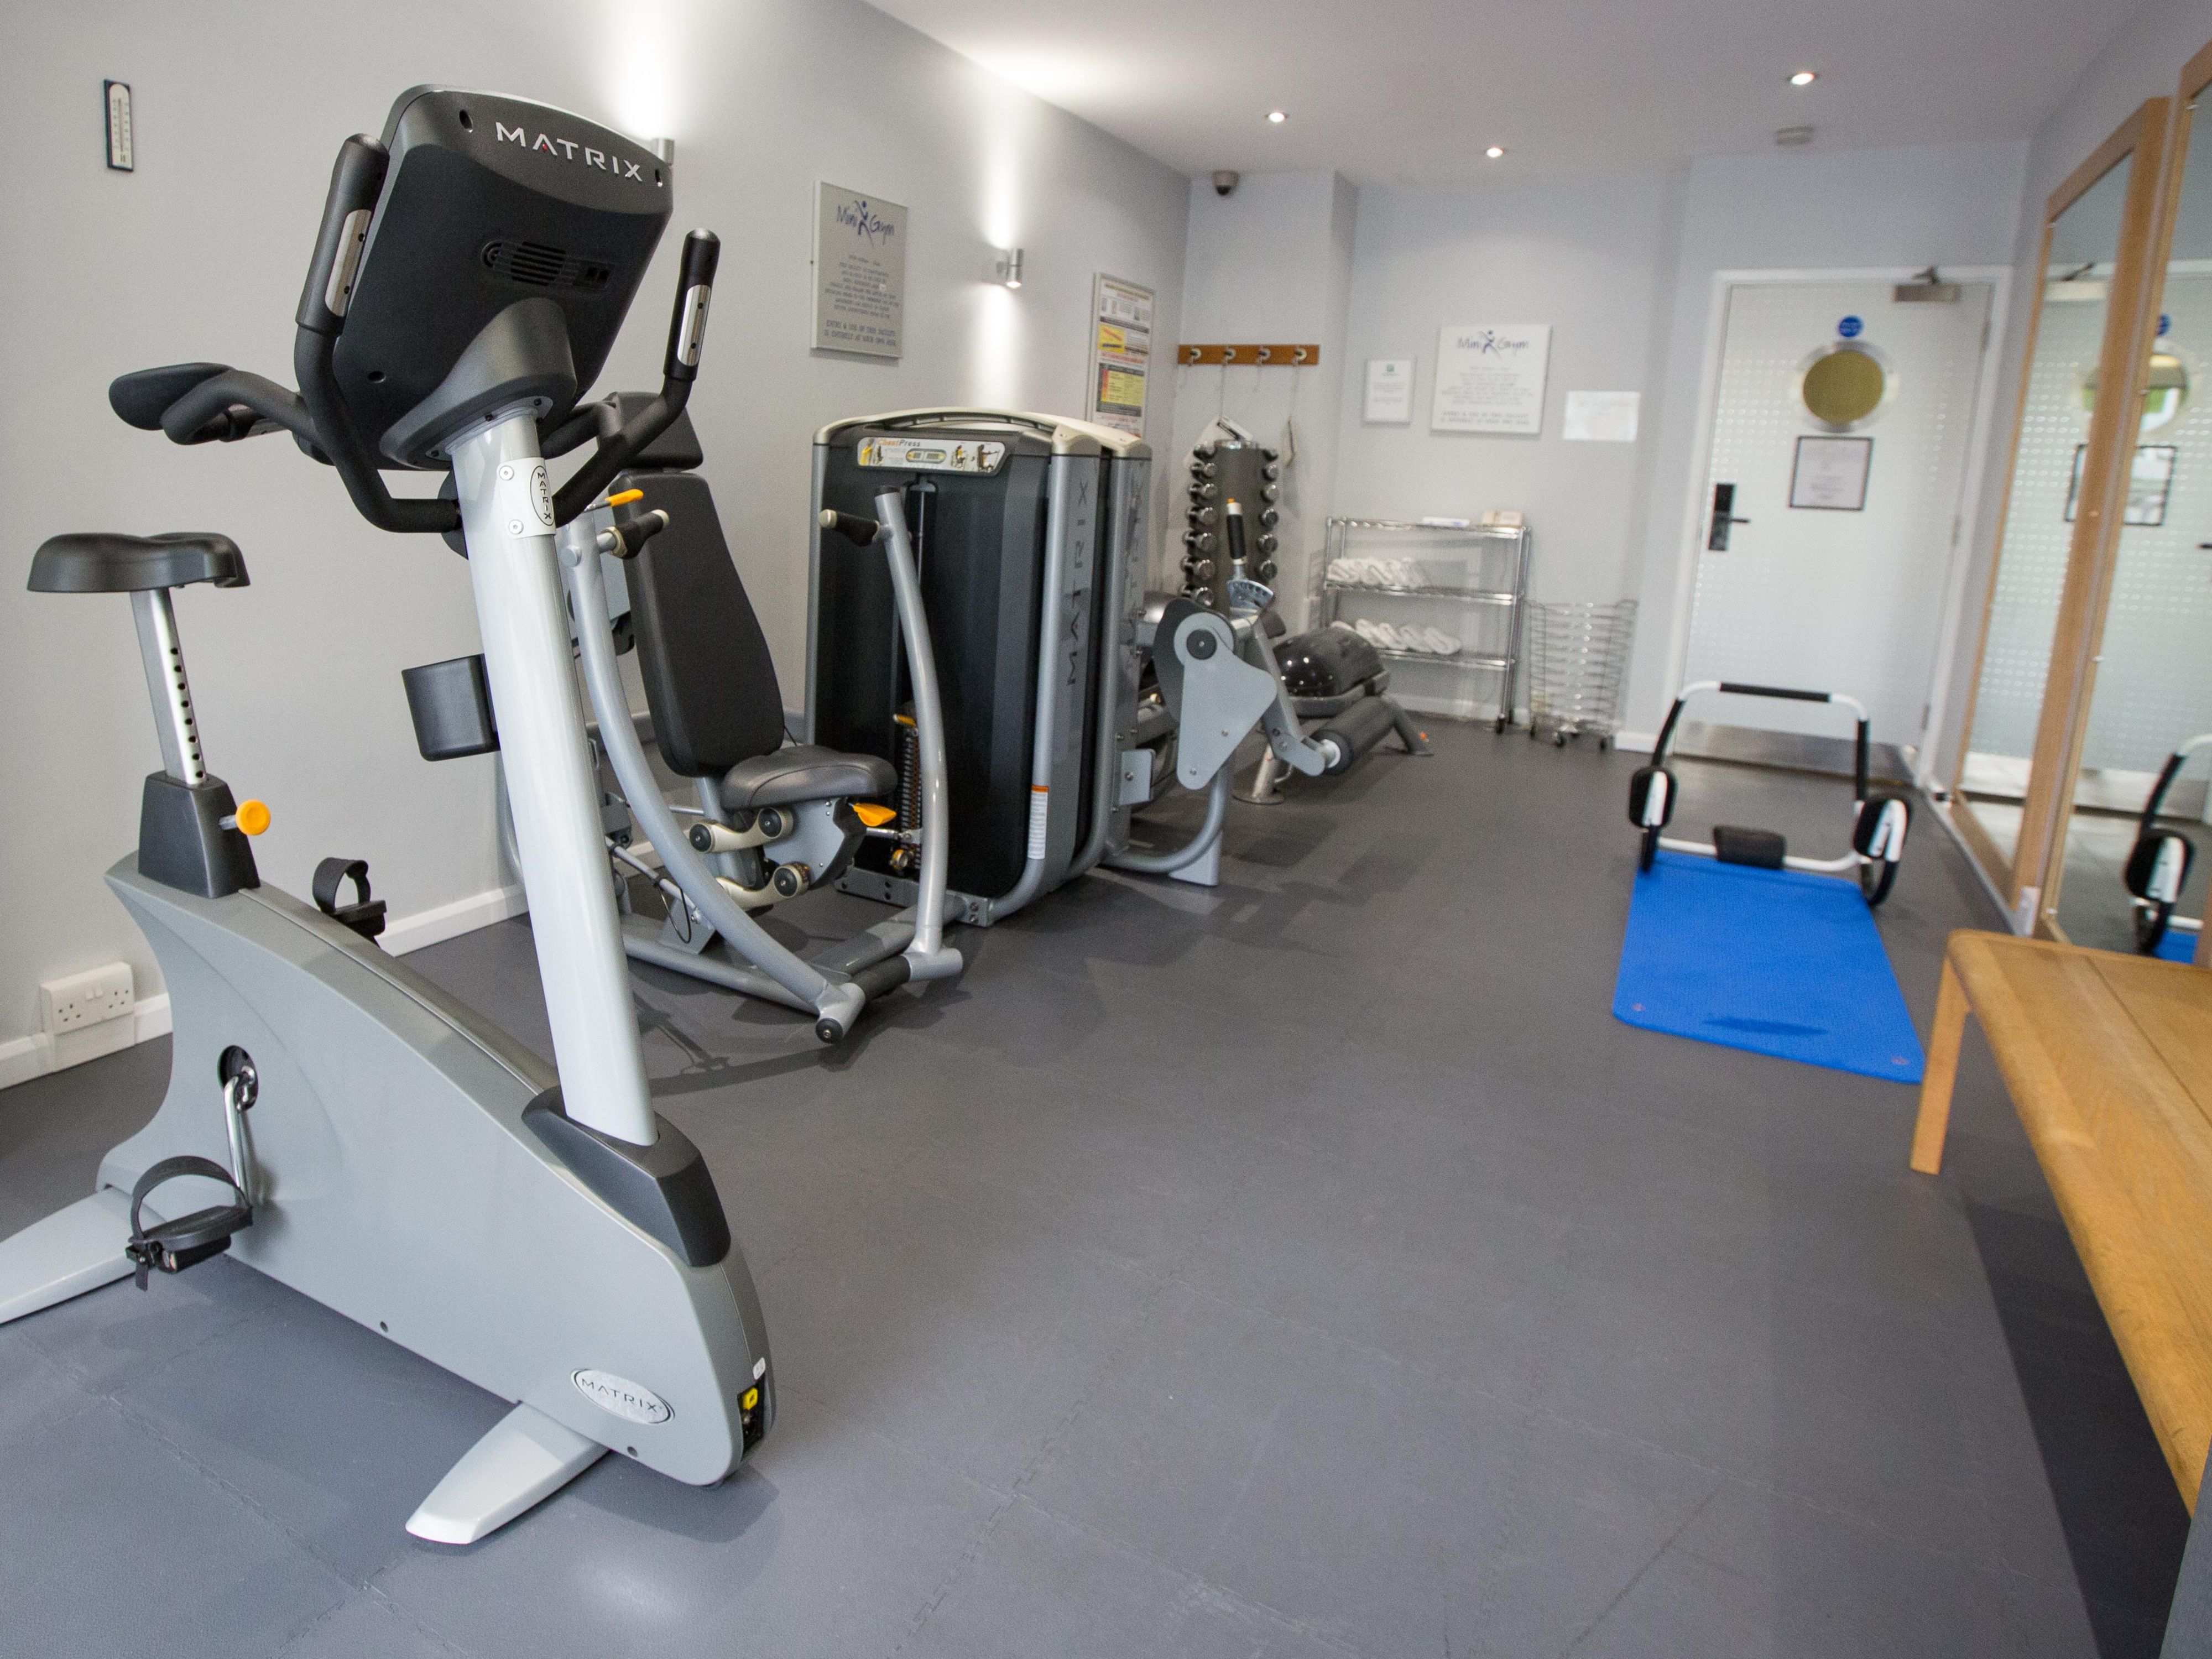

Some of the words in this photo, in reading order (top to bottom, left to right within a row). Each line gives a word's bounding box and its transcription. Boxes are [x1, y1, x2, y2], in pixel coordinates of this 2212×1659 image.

[495, 122, 643, 182] MATRIX
[869, 214, 895, 245] Gym
[1497, 336, 1530, 356] Gym
[537, 472, 552, 520] MATRIX
[1067, 481, 1089, 685] MATRIX
[582, 1378, 658, 1413] MATRIX
